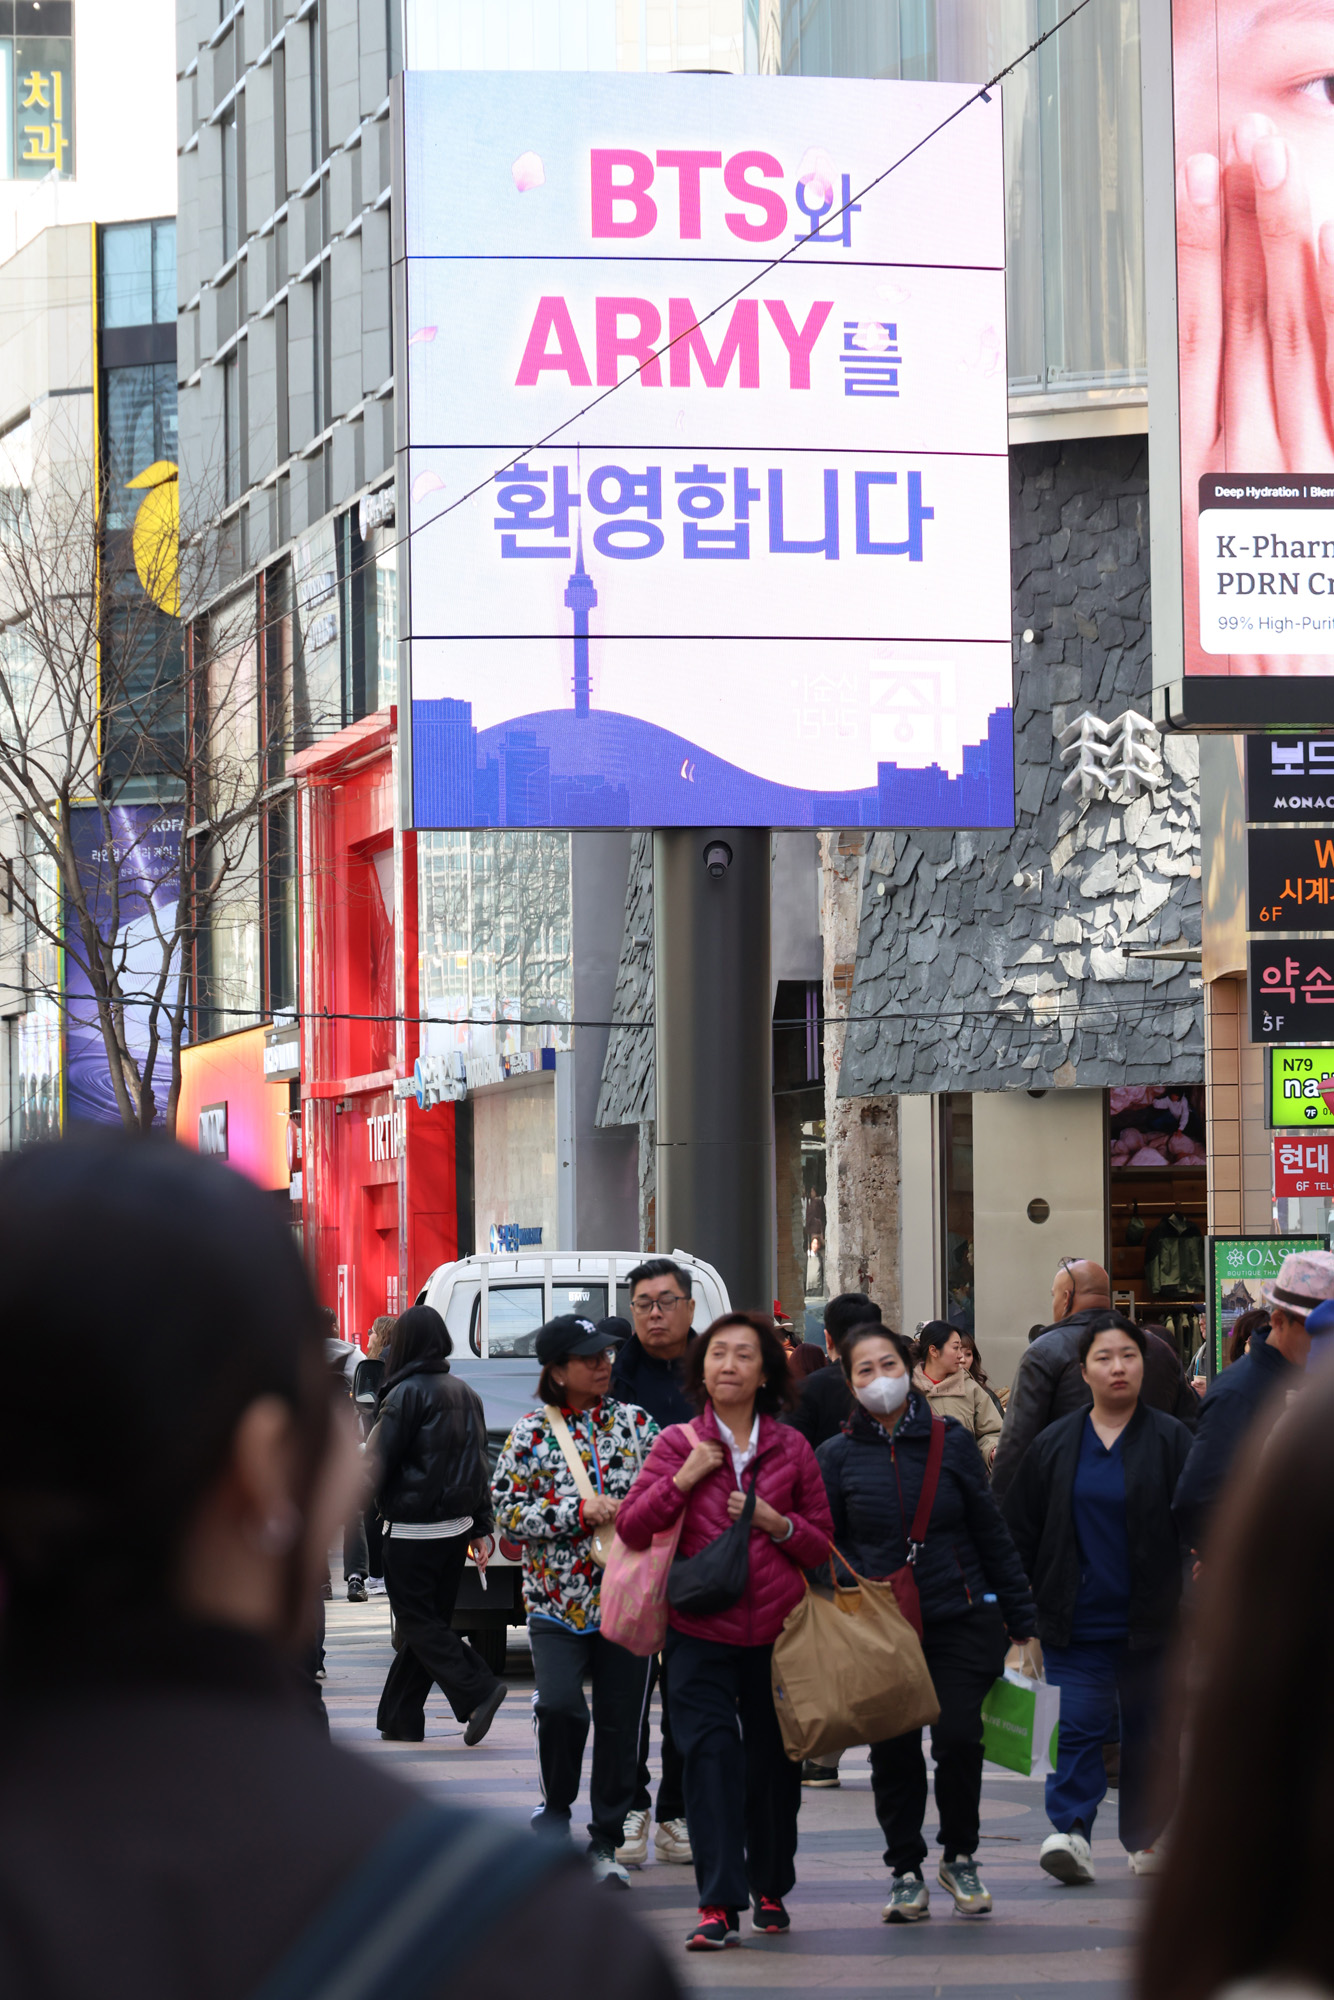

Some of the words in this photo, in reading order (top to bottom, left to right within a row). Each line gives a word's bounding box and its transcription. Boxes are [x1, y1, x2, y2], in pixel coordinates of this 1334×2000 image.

[22, 71, 69, 171] 치과
[590, 148, 862, 248] BTS와
[514, 296, 903, 398] ARMY를
[1214, 486, 1245, 499] Deep
[1246, 486, 1300, 499] Hydration
[494, 462, 935, 562] 환영합니다
[1217, 572, 1300, 595] PDRN
[1218, 616, 1254, 630] 99%
[1279, 877, 1334, 905] 시계
[1259, 906, 1283, 922] 6F
[1260, 956, 1334, 1004] 약손
[1262, 1015, 1285, 1032] 5F
[1283, 1058, 1313, 1072] N79
[1305, 1108, 1317, 1118] 7F
[1279, 1144, 1329, 1174] 현대
[1296, 1181, 1310, 1192] 6F
[1314, 1182, 1331, 1191] TEL
[1246, 1248, 1306, 1267] OAS
[568, 1291, 590, 1302] BMW
[1003, 1720, 1028, 1737] YOUNG
